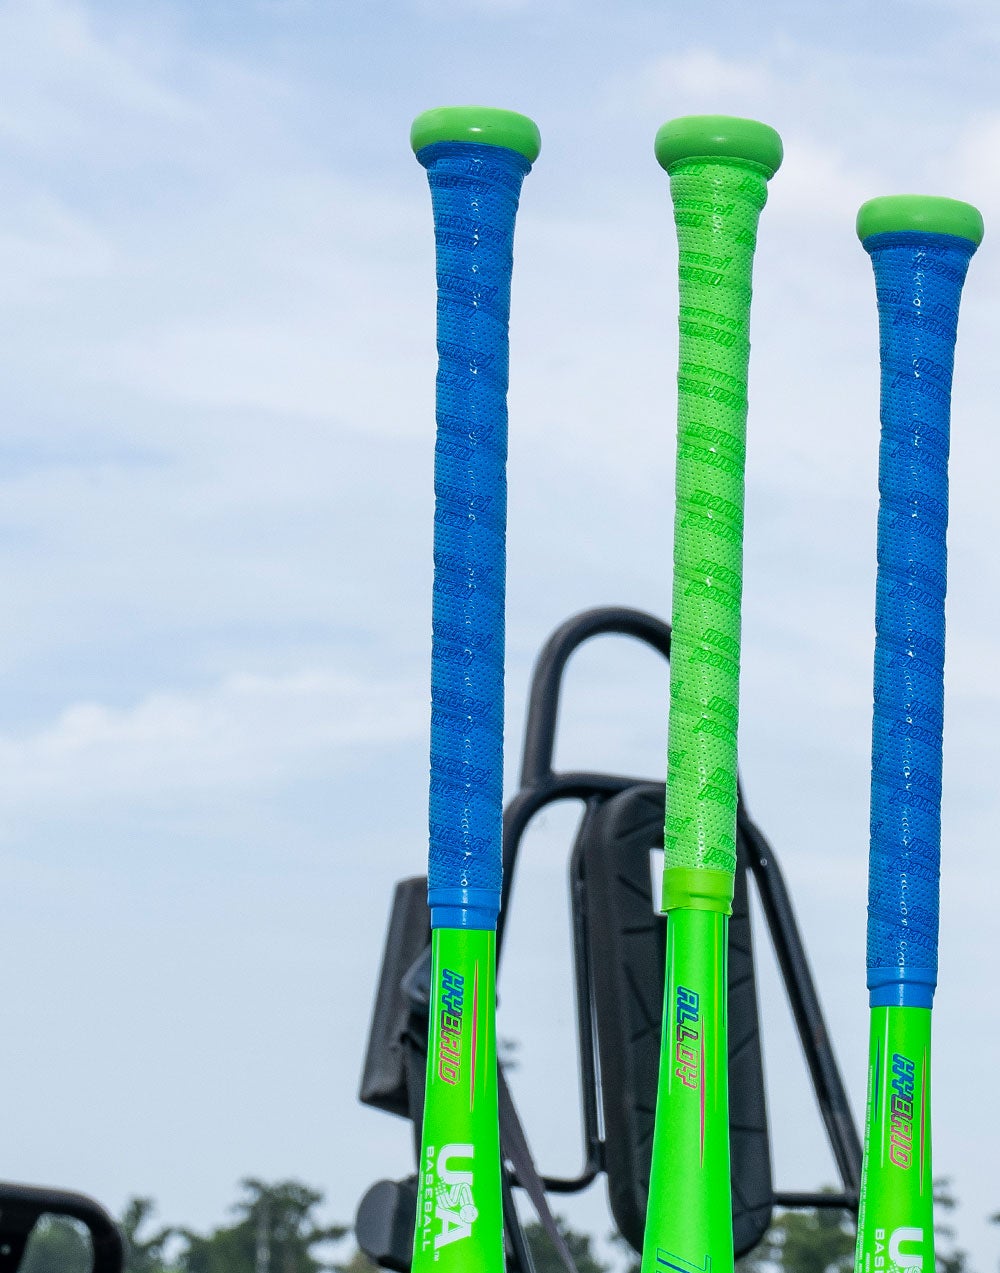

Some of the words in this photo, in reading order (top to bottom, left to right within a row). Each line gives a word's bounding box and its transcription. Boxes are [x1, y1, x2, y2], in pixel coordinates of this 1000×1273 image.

[439, 968, 466, 1086] HYBRID
[676, 985, 700, 1091] ALLOY
[889, 1052, 916, 1170] HYBRID
[422, 1146, 434, 1251] BASEBALL
[434, 1143, 479, 1250] USA
